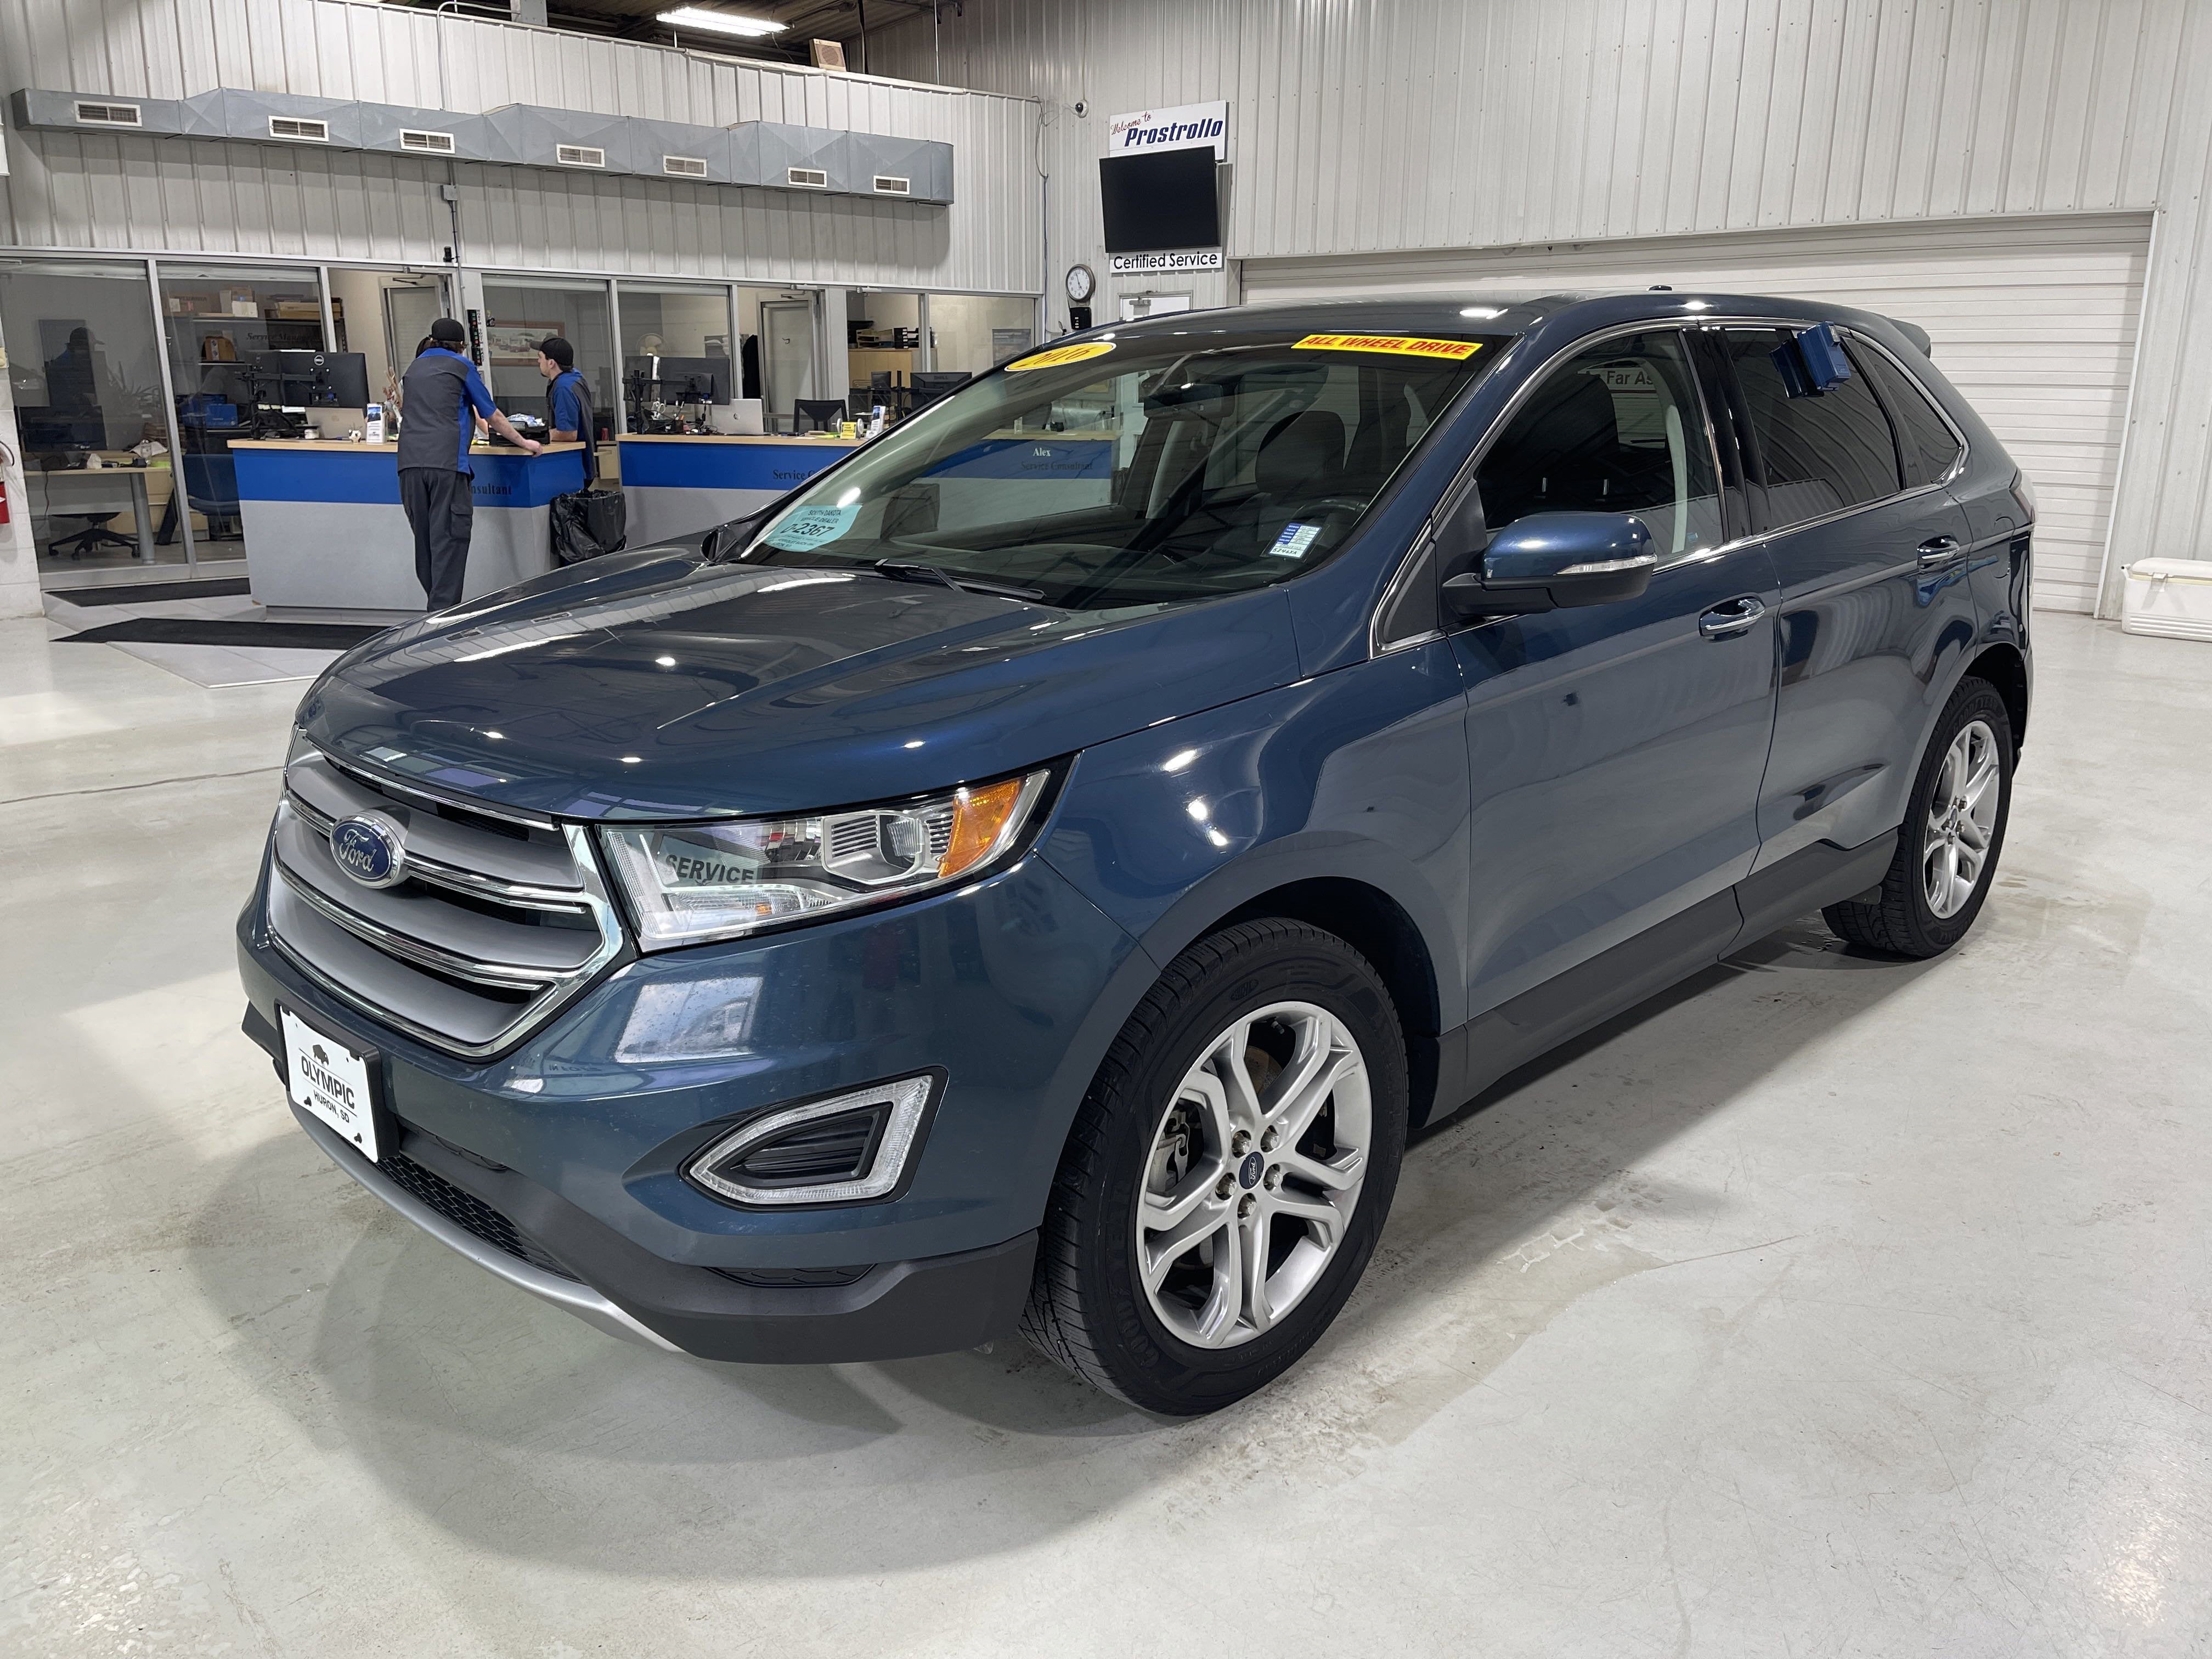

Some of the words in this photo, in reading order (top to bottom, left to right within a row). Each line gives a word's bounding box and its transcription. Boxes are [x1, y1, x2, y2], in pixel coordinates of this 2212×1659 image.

[1110, 117, 1141, 135] Welcome
[1142, 111, 1152, 122] to
[1124, 118, 1223, 147] Prostrollo
[1114, 253, 1166, 269] Certified
[1169, 251, 1217, 267] Service
[1301, 336, 1338, 346] ALL
[1339, 337, 1404, 349] WHEEL
[1405, 340, 1475, 356] DRIVE
[1606, 370, 1630, 385] Far
[1032, 448, 1051, 456] Alex
[772, 469, 806, 480] Service
[1021, 461, 1048, 470] Service
[1051, 461, 1093, 470] Consultant
[471, 483, 512, 495] nsultant
[339, 828, 378, 872] Ford
[665, 854, 754, 884] SERVICE
[301, 1055, 355, 1110] OLYMPIC
[314, 1090, 339, 1118] HURON,
[340, 1109, 349, 1124] SD
